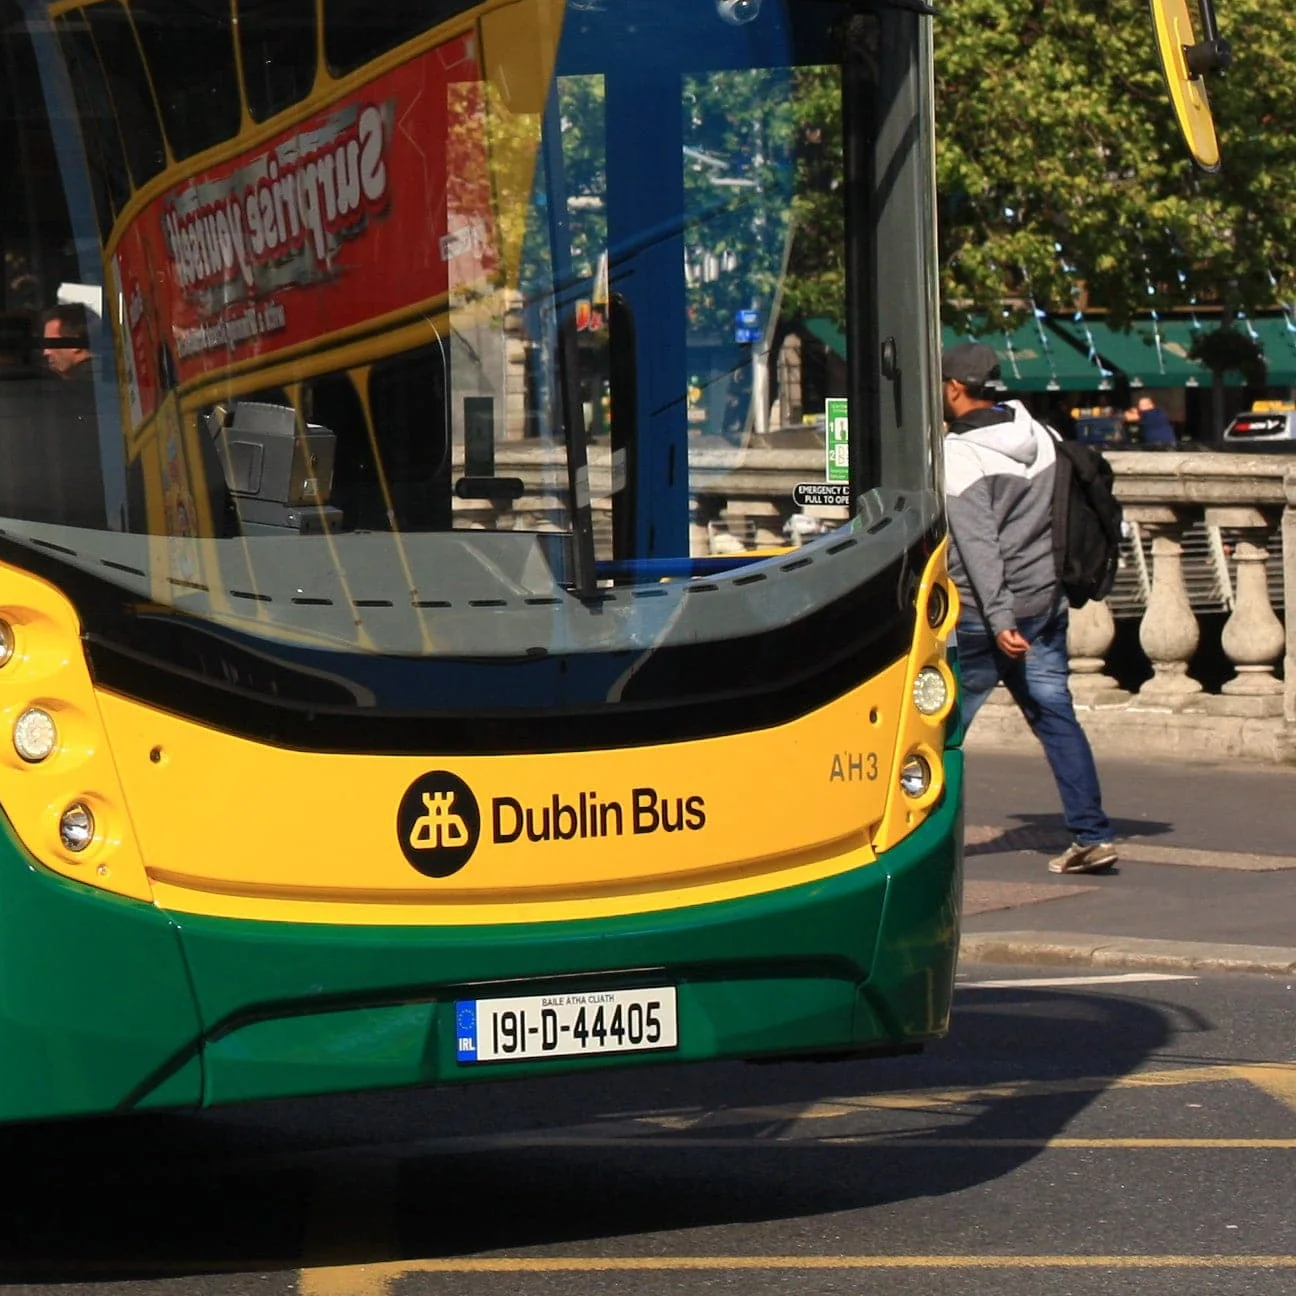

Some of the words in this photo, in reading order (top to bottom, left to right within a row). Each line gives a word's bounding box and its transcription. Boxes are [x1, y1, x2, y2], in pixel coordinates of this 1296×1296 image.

[491, 791, 623, 844] Dublin
[631, 787, 706, 835] Bus
[541, 997, 564, 1007] BAILE
[587, 994, 615, 1004] CLIATH
[492, 1001, 661, 1054] 191-D-44405
[458, 1038, 476, 1051] IRL
